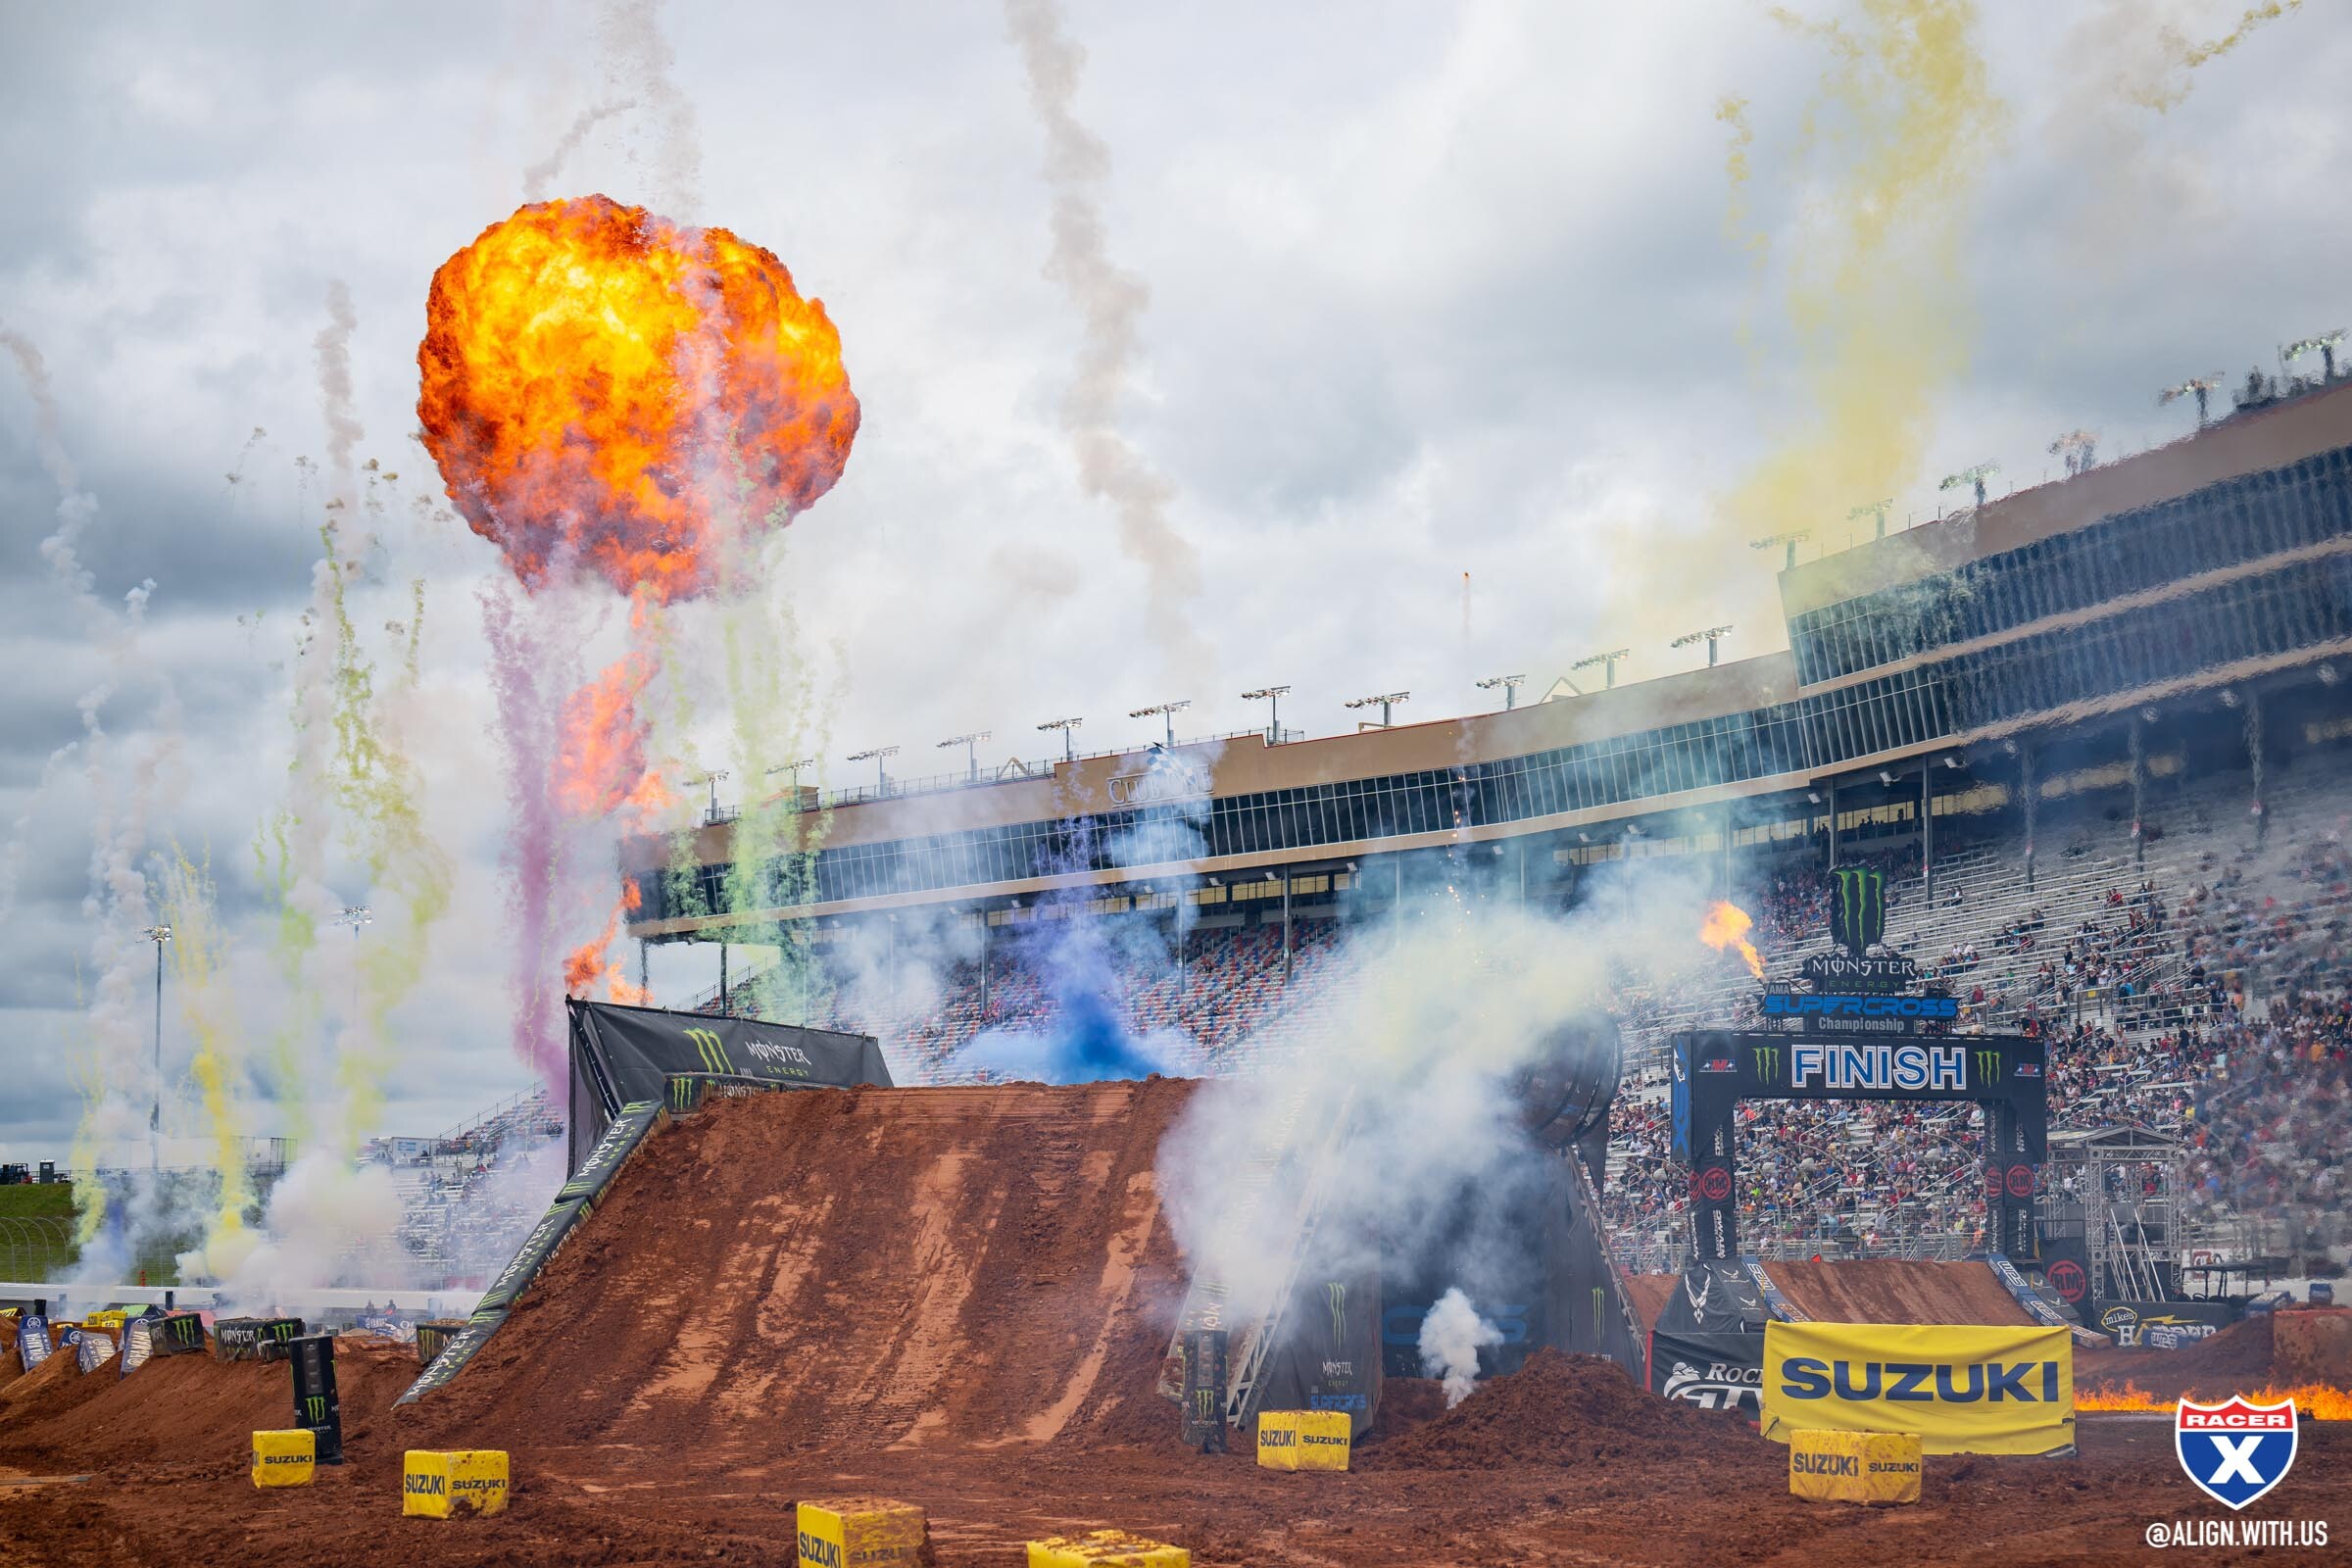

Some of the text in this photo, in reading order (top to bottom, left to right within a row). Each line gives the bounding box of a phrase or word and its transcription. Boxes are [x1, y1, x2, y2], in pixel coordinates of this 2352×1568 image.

[1108, 777, 1160, 804] CLUB
[1813, 957, 1916, 978] MONSTER
[1769, 984, 1790, 995] AMA
[1830, 980, 1900, 989] ENERGY
[1764, 994, 1959, 1016] SUPERCROSS
[1819, 1017, 1905, 1033] Championship
[745, 1040, 811, 1066] MONSTER
[766, 1065, 809, 1077] ENERGY
[1791, 1044, 1967, 1091] FINISH
[577, 1117, 633, 1177] MONSTER
[496, 1219, 555, 1288] MONSTER
[2104, 1311, 2135, 1326] mike's
[220, 1326, 256, 1346] MONSTER
[407, 1329, 477, 1396] MONSTER
[1322, 1357, 1353, 1376] MONSTER
[1781, 1357, 2059, 1403] SUZUKI
[1260, 1429, 1297, 1447] SUZUKI
[1302, 1435, 1348, 1446] SUZUKI
[265, 1454, 313, 1464] SUZUKI
[1793, 1452, 1859, 1477] SUZUKI
[1868, 1462, 1920, 1474] SUZUKI
[405, 1473, 446, 1495] SUZUKI
[452, 1479, 506, 1490] SUZUKI
[799, 1531, 841, 1568] SUZUKI
